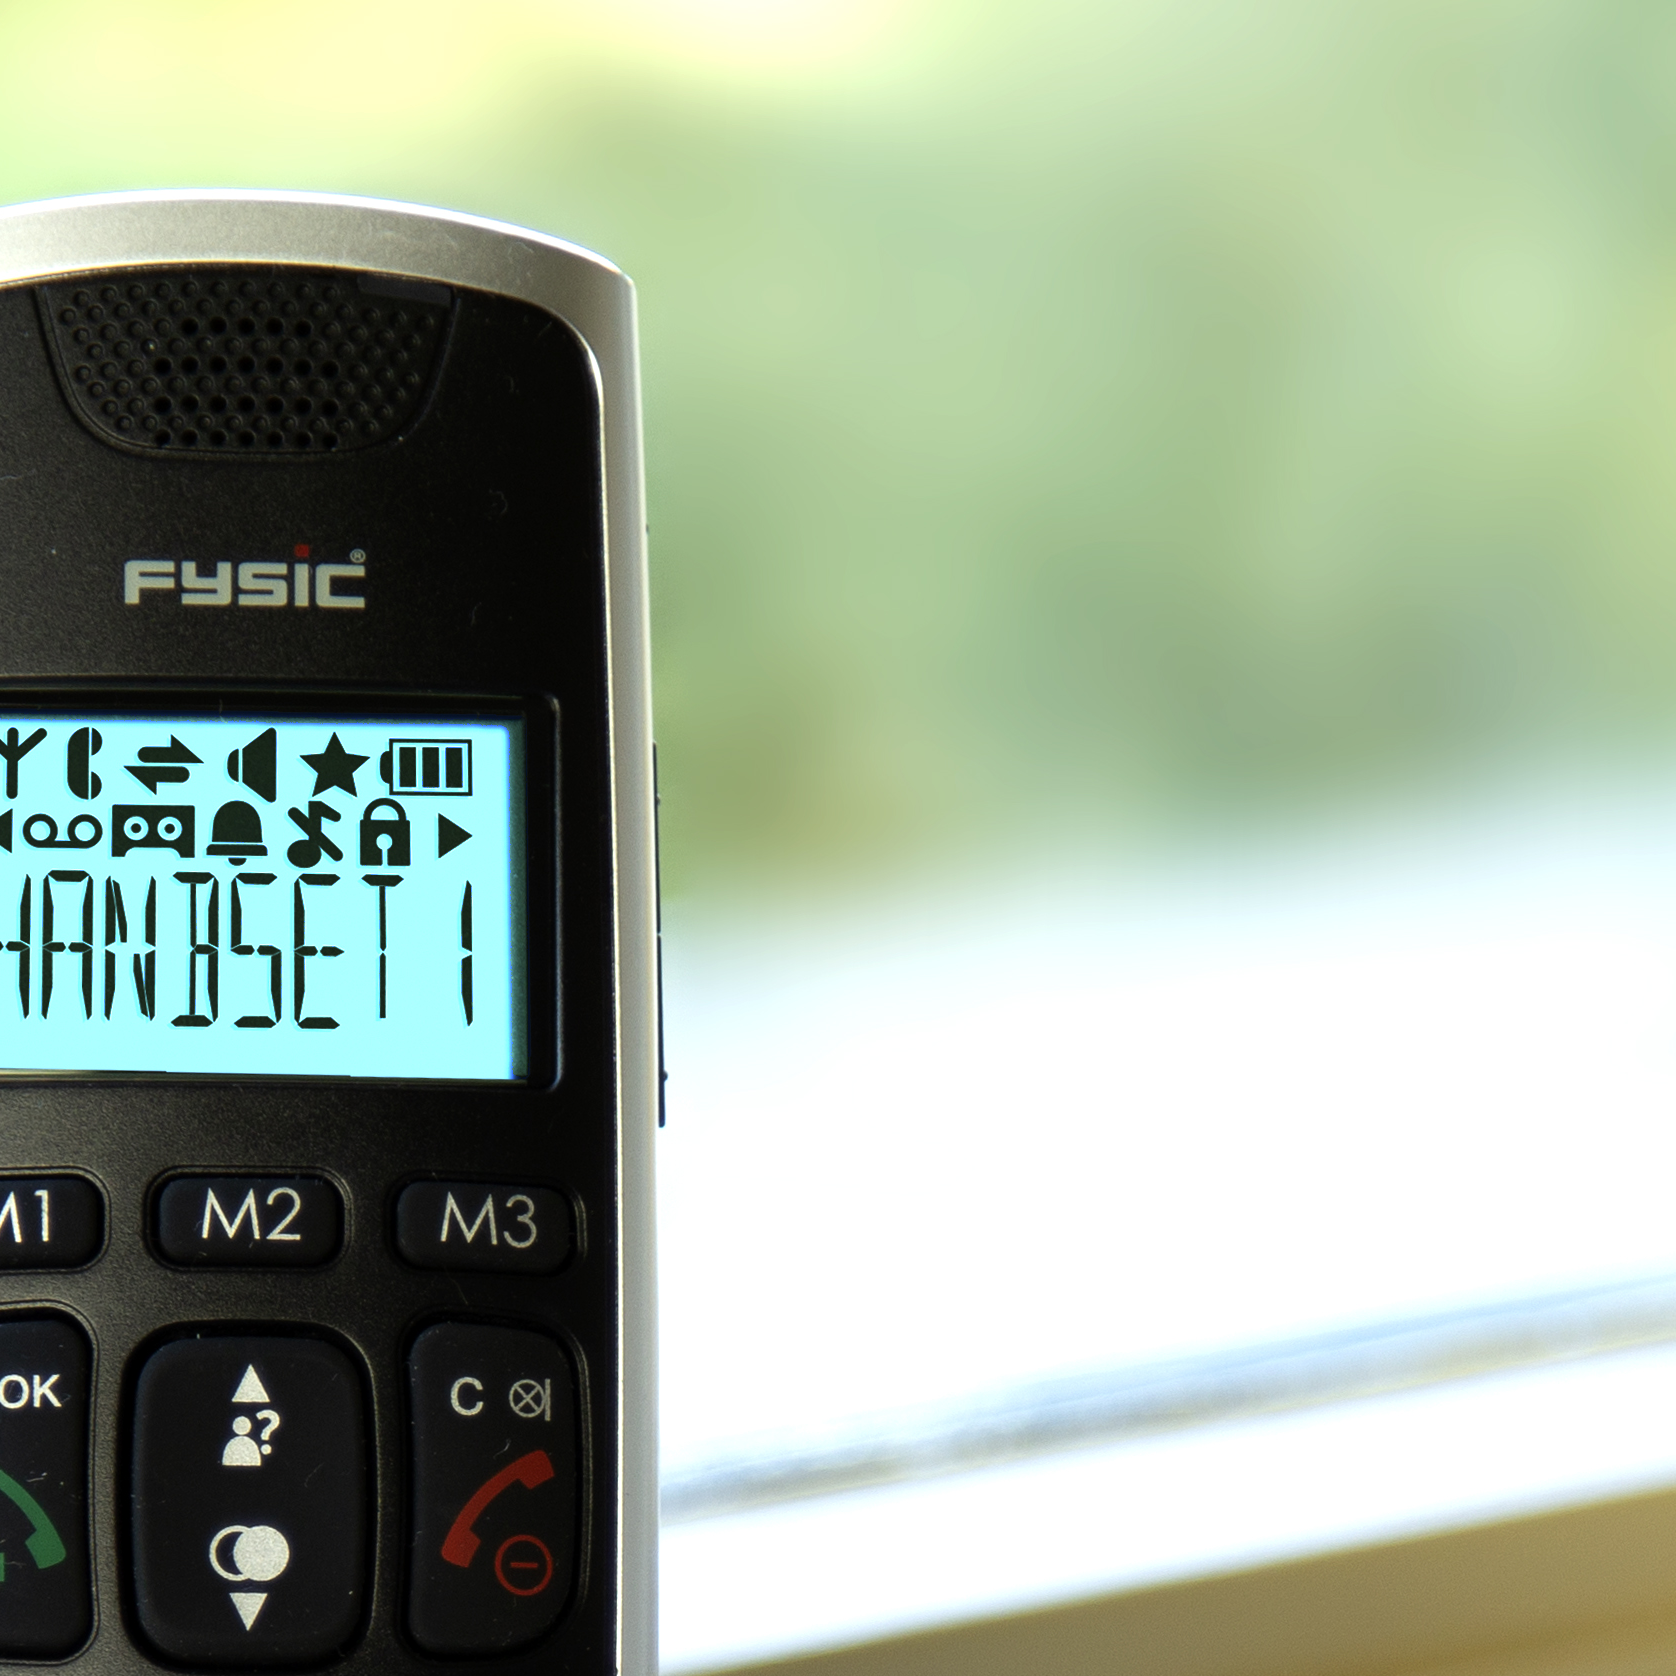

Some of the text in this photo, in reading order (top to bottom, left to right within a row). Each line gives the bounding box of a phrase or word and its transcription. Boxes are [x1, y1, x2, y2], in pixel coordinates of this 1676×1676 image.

[461, 880, 474, 1027] 1
[201, 1187, 302, 1241] M2
[440, 1192, 537, 1248] M3
[450, 1376, 484, 1416] C
